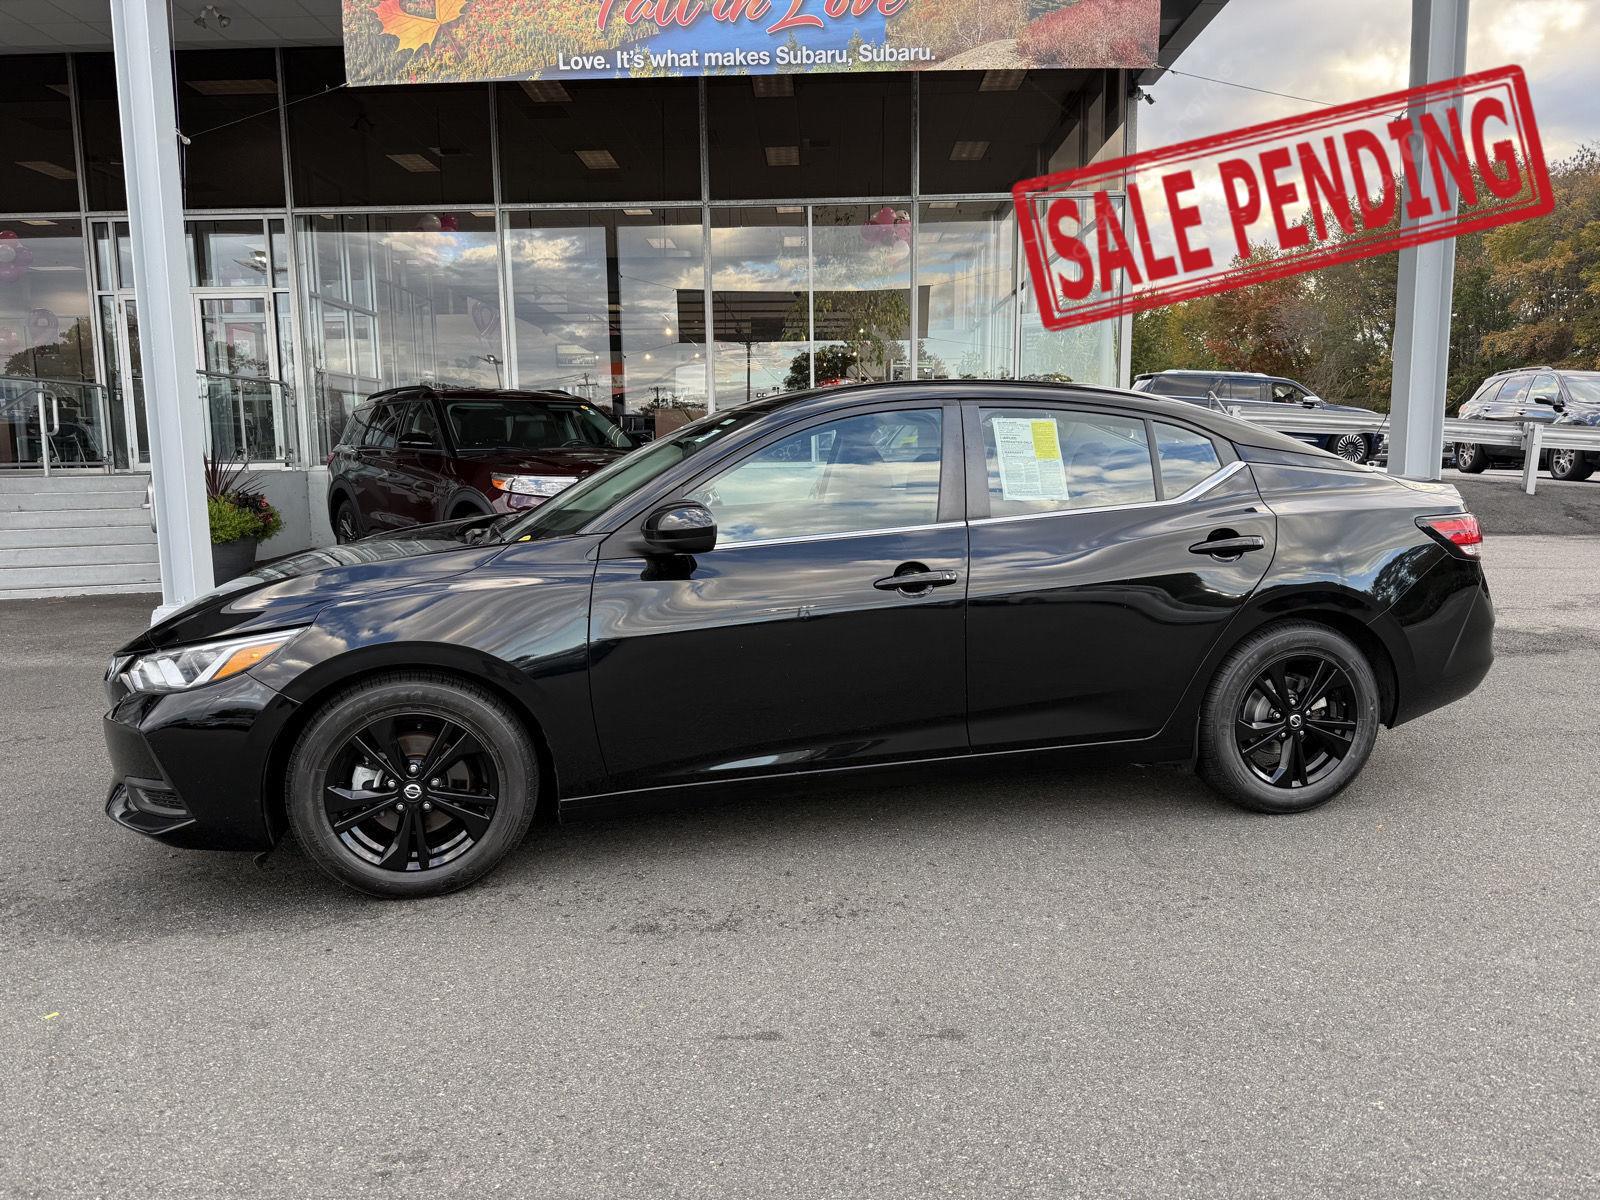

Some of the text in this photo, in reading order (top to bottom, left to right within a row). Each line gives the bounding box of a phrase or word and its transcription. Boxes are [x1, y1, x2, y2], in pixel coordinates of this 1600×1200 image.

[712, 0, 772, 23] in
[766, 0, 904, 34] Love
[558, 44, 936, 71] Love. It's what makes Subaru, Subaru.
